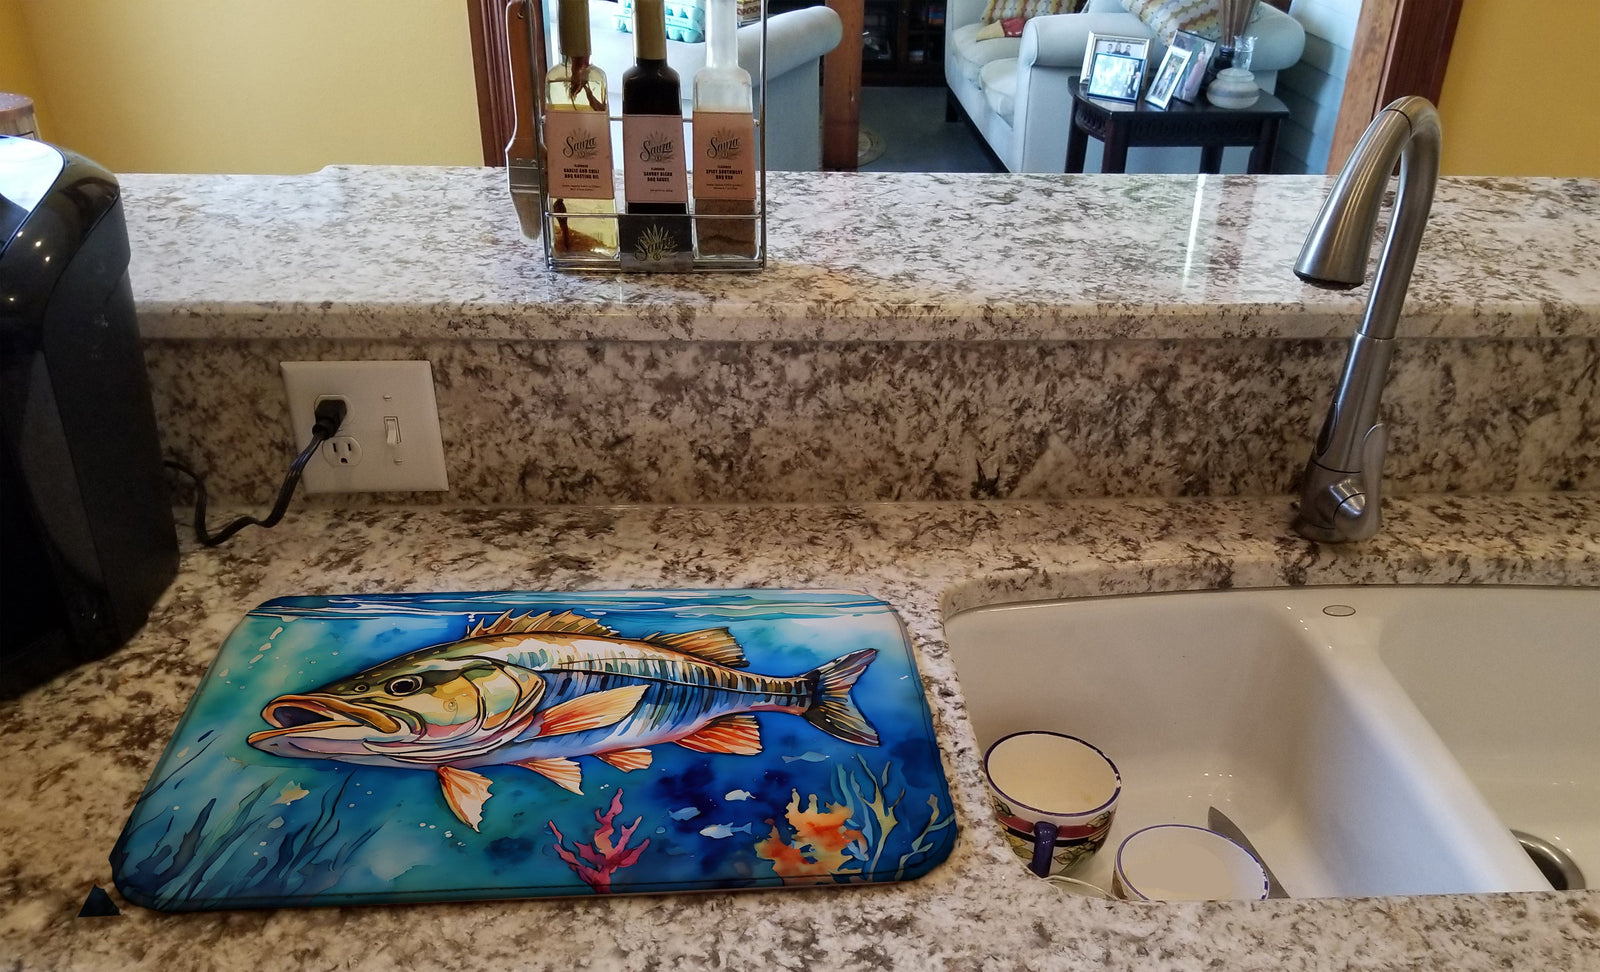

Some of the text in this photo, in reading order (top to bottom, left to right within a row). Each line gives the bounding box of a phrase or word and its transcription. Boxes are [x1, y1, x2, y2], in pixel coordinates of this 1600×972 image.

[563, 136, 597, 158] Sauza
[640, 140, 673, 162] Sauza
[707, 136, 740, 159] Sauza
